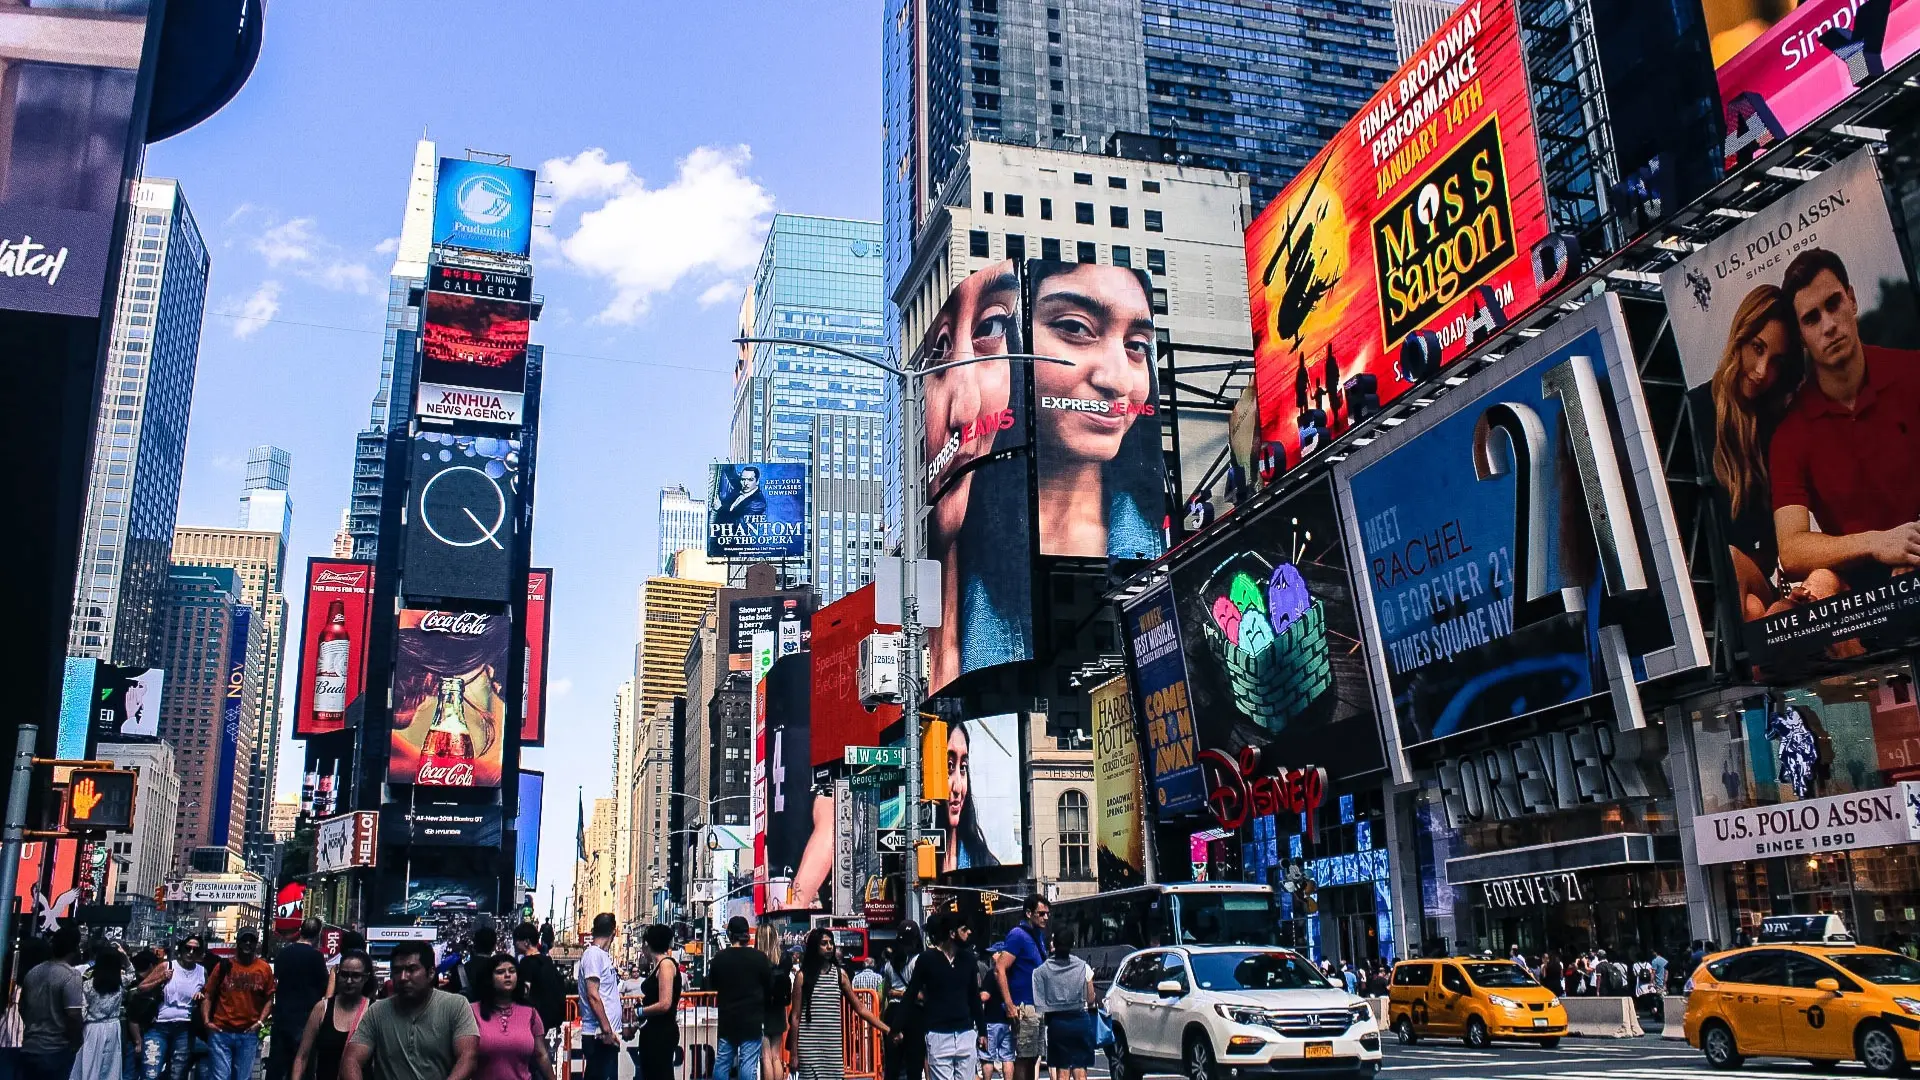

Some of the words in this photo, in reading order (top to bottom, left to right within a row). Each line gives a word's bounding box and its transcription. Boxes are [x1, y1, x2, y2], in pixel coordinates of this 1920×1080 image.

[1358, 102, 1397, 148] FINAL
[1399, 1, 1484, 102] BROADWAY
[1372, 45, 1479, 168] PERFORMANCE
[1376, 122, 1439, 200] JANUARY
[1444, 78, 1485, 135] 14TH
[453, 220, 510, 238] Prudential
[1714, 252, 1745, 280] U.S.
[1745, 222, 1793, 262] POLO
[1797, 188, 1851, 232] ASSN.
[0, 235, 68, 286] atch
[1387, 204, 1507, 327] Saigon
[1746, 254, 1782, 281] SINCE
[1787, 232, 1818, 256] 1890
[443, 280, 516, 297] GALLERY
[484, 274, 517, 285] XINHUA
[426, 403, 462, 416] NEWS
[464, 406, 516, 421] AGENCY
[440, 391, 502, 409] XINHUA
[1041, 396, 1110, 413] EXPRESS
[1110, 401, 1155, 416] JEANS
[928, 431, 960, 484] EXPRESS
[960, 408, 1015, 447] JEANS
[1473, 356, 1647, 632] 21
[710, 521, 802, 537] PHANTOM
[744, 514, 767, 523] THE
[1363, 505, 1400, 556] MEET
[718, 536, 732, 545] OF
[734, 536, 756, 545] THE
[758, 535, 793, 544] OPERA
[1373, 519, 1472, 592] RACHEL
[320, 571, 360, 582] Budweiser
[1398, 560, 1480, 627] FOREVER
[420, 609, 491, 635] Coca-Cola
[738, 629, 753, 637] good
[783, 625, 796, 634] bai
[1766, 614, 1799, 634] LIVE
[1767, 632, 1792, 645] PAMELA
[1793, 622, 1831, 638] FLANAGAN
[1840, 612, 1865, 625] JONNY
[1867, 602, 1895, 617] LAVINE
[1832, 616, 1888, 637] USPOLOASSN.COM
[1134, 632, 1149, 658] BEST
[1149, 619, 1176, 650] MUSICAL
[1389, 632, 1432, 675] TIMES
[1433, 607, 1487, 663] SQUARE
[1145, 680, 1188, 721] COME
[1097, 717, 1134, 760] POTTE
[859, 748, 869, 763] W
[875, 749, 888, 763] 45
[893, 749, 902, 759] St
[1102, 757, 1119, 774] CURSED
[1120, 752, 1135, 767] CHILD
[1156, 737, 1194, 777] AWAY
[418, 761, 474, 787] Coca-Cola
[851, 773, 876, 786] George
[1049, 769, 1066, 778] THE
[1433, 720, 1632, 828] FOREVER
[1106, 792, 1133, 808] BROADWAY
[1106, 804, 1124, 818] SPRING
[1714, 816, 1753, 841] U.S.
[1757, 806, 1820, 837] POLO
[1827, 795, 1901, 828] ASSN.
[886, 837, 905, 845] ONE
[1756, 838, 1804, 854] SINCE
[1812, 832, 1856, 848] 1890
[194, 883, 226, 891] PEDESTRIAN
[1483, 875, 1560, 909] FOREVER
[1561, 872, 1583, 901] 21
[327, 931, 339, 955] tkts
